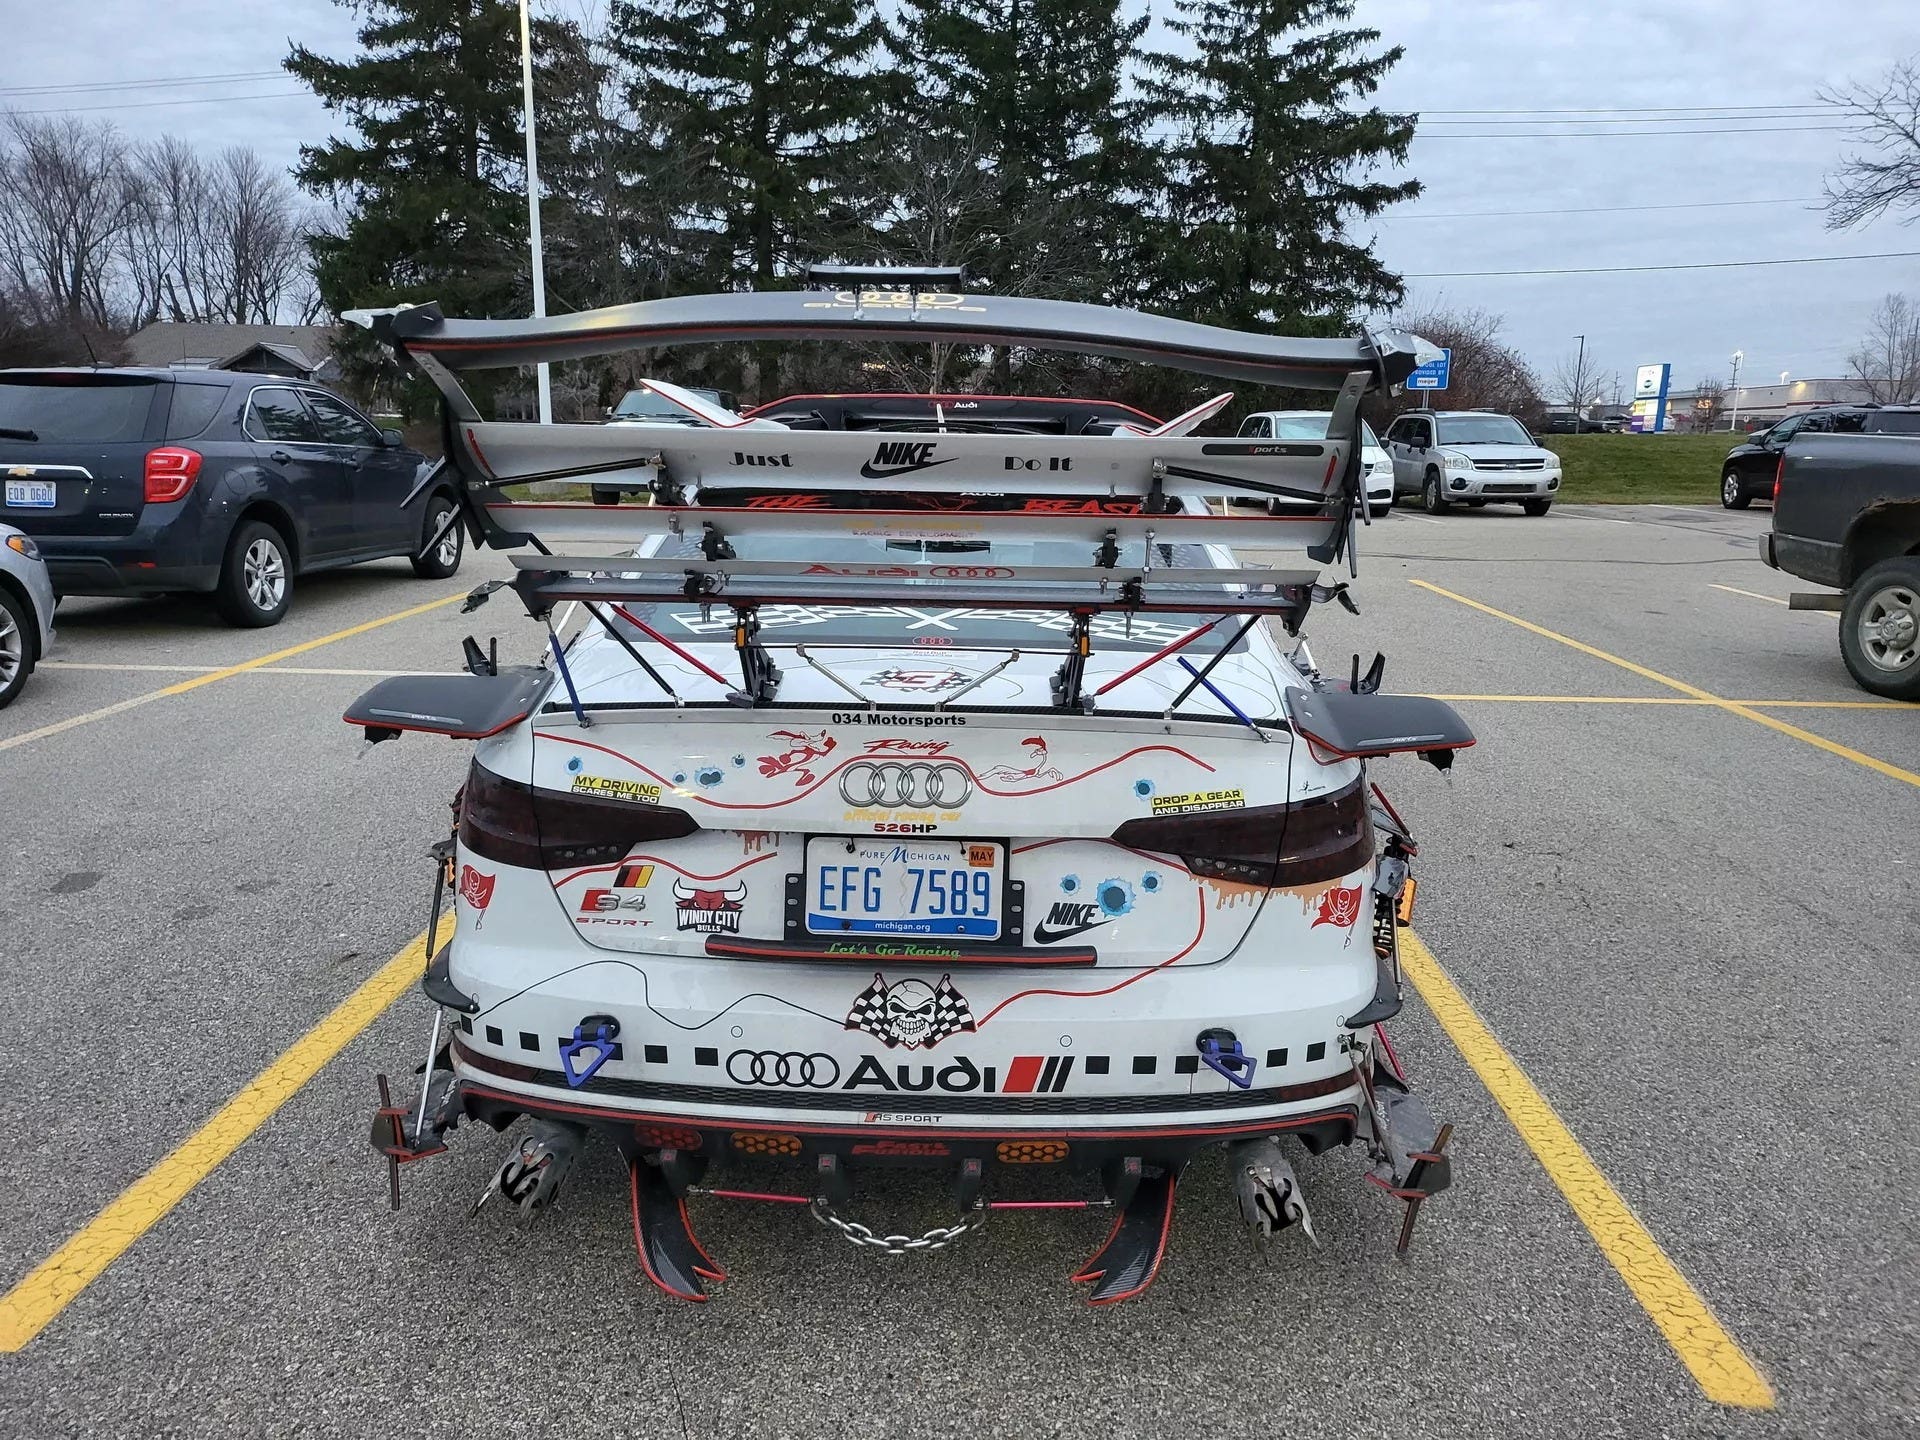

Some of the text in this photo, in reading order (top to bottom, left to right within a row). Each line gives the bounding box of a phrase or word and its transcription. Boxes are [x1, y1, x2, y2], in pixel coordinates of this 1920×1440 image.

[729, 452, 793, 467] Just
[873, 442, 937, 466] NIKE
[1004, 456, 1073, 471] Do It
[800, 564, 919, 577] Audi
[831, 713, 967, 727] 034 Motorsports
[863, 739, 955, 755] Racing
[574, 776, 660, 795] MY DRIVING
[572, 786, 658, 804] SCARES ME TOO
[1153, 790, 1241, 806] DROP A GEAR
[1154, 800, 1244, 815] AND DISAPPEAR
[873, 823, 938, 834] 526HP
[860, 846, 950, 865] PURE MICHIGAN
[970, 851, 994, 861] MAY
[819, 866, 990, 916] EFG 7589
[594, 894, 647, 911] S4
[575, 917, 654, 927] SPORT
[678, 909, 740, 929] WINDY CITY
[1046, 902, 1100, 926] NIKE
[697, 924, 721, 933] BULLS
[875, 921, 931, 932] michigan.org
[824, 943, 961, 960] Let's Go Racing
[841, 1055, 996, 1093] Audi
[895, 1114, 942, 1123] SPORT
